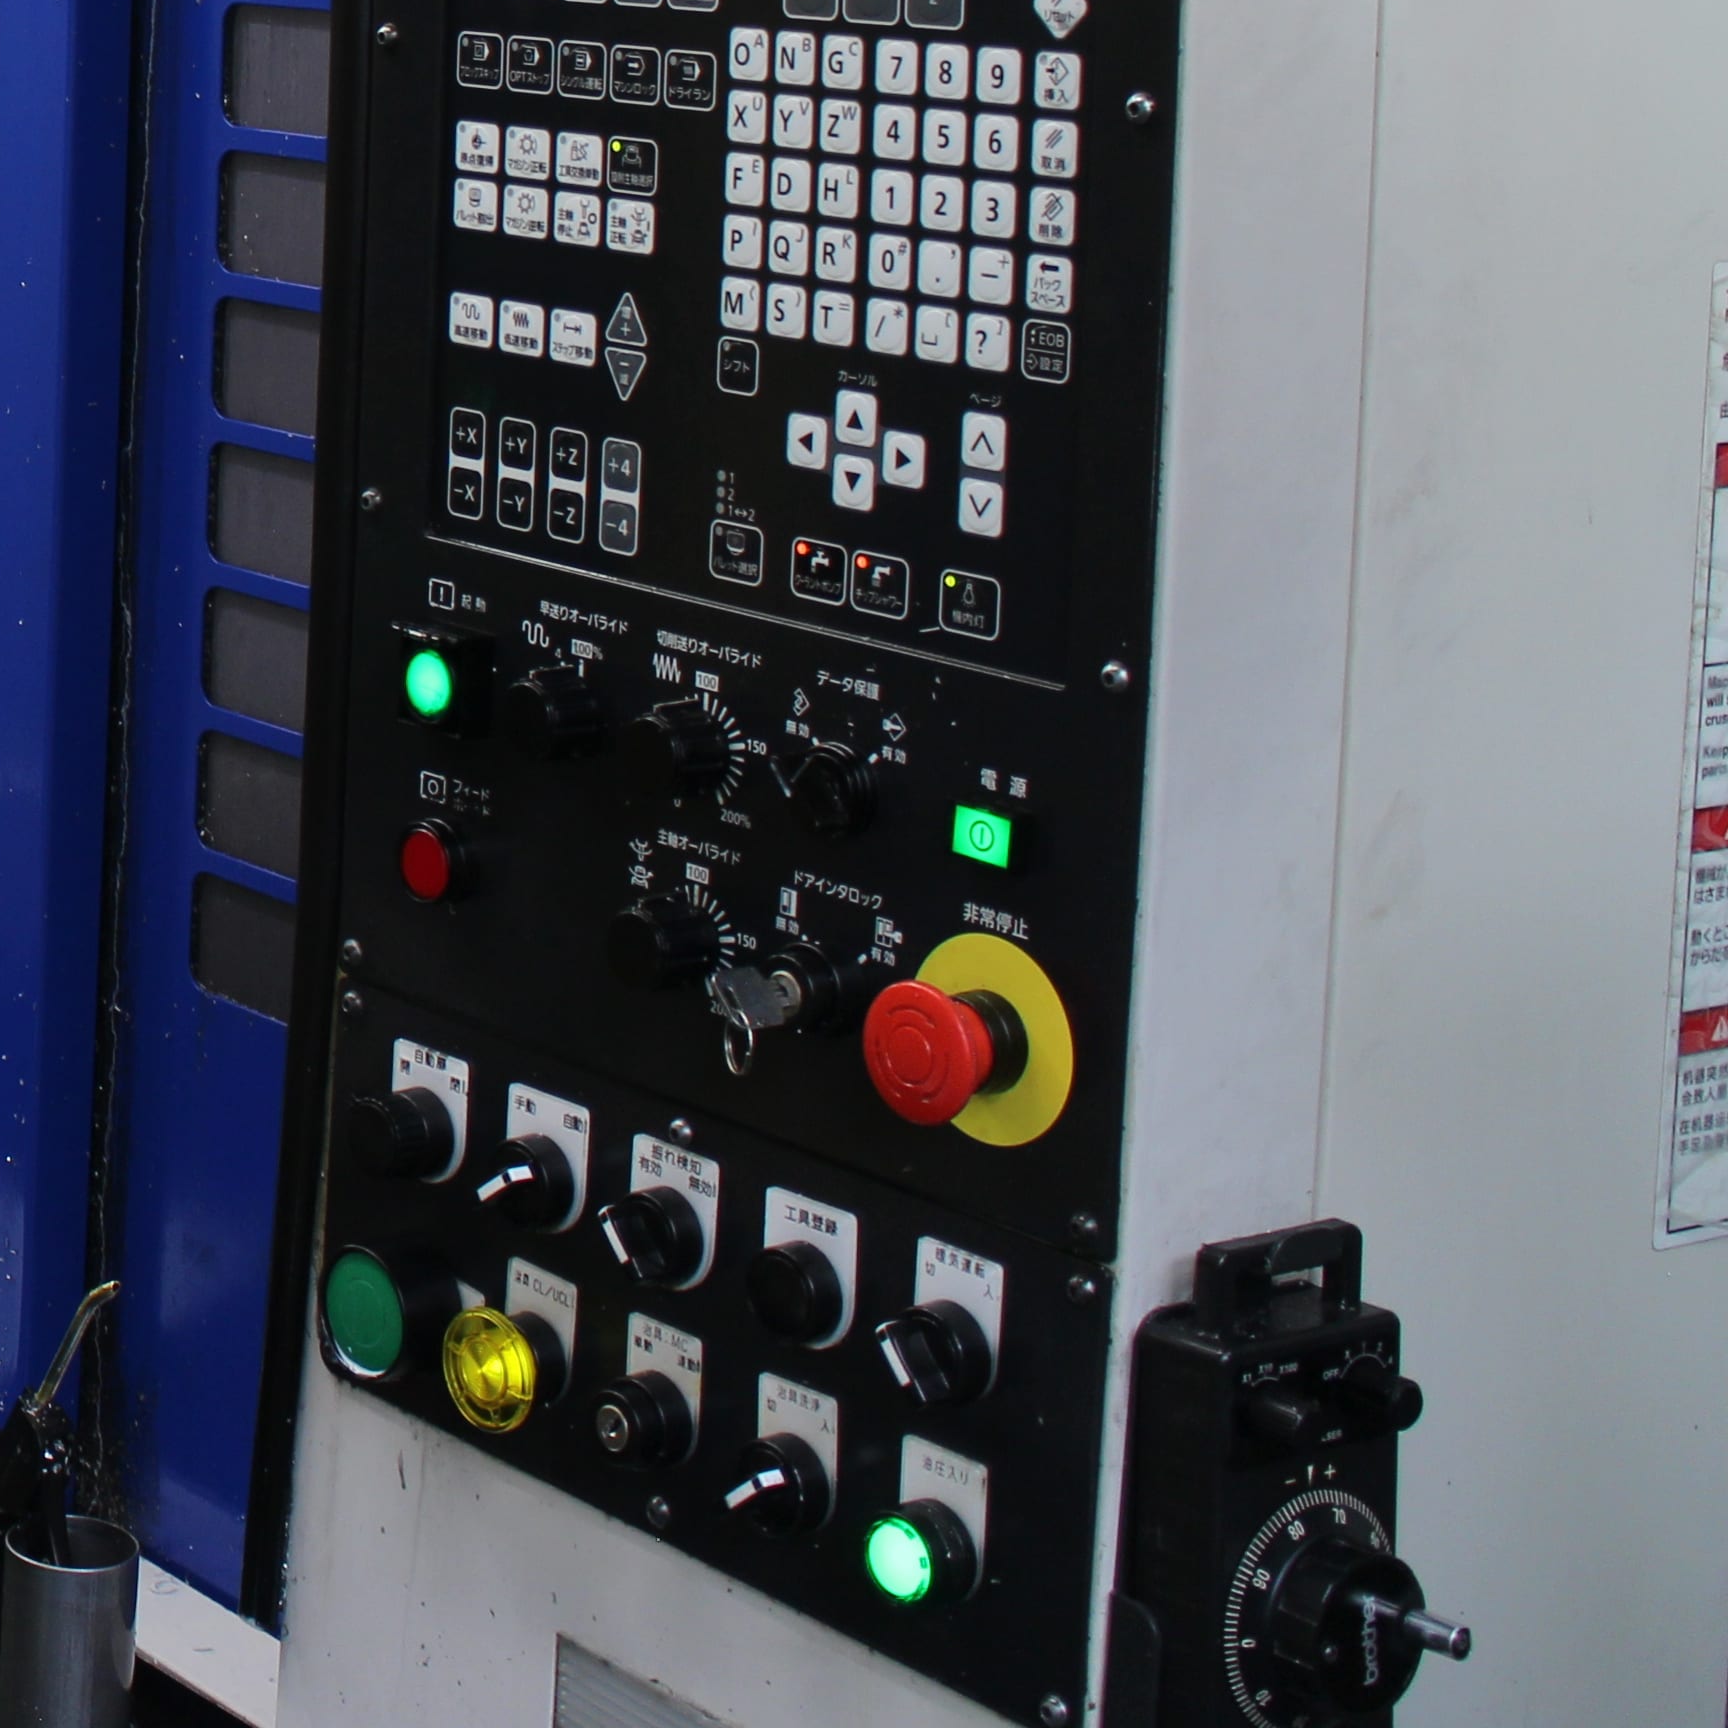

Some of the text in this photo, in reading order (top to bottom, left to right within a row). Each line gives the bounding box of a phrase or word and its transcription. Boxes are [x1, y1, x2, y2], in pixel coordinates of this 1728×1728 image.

[781, 47, 795, 70] N
[829, 51, 843, 73] G
[891, 56, 903, 79] 7
[940, 60, 951, 84] 8
[992, 65, 1003, 88] 9
[668, 87, 711, 101] ドライラン
[733, 105, 747, 128] X
[780, 109, 792, 132] Y
[828, 114, 839, 138] Z
[887, 120, 900, 143] 4
[938, 125, 949, 148] 5
[989, 130, 1001, 153] 6
[733, 167, 743, 190] F
[777, 173, 792, 195] D
[825, 178, 838, 201] H
[935, 192, 947, 216] 2
[987, 198, 998, 222] 3
[731, 230, 742, 252] P
[774, 235, 790, 261] Q
[823, 242, 835, 266] R
[882, 249, 893, 273] 0
[725, 291, 743, 315] M
[775, 299, 785, 323] S
[821, 306, 833, 329] T
[724, 359, 749, 373] シフト
[838, 370, 877, 387] カーソル
[456, 426, 477, 444] +X
[506, 436, 527, 454] +Y
[556, 448, 578, 466] +Z
[609, 457, 630, 476] +4
[696, 674, 717, 690] 100
[747, 739, 766, 755] 150
[688, 866, 708, 882] 100
[794, 870, 882, 910] ドアインタロック
[963, 902, 1028, 940] 非常停止
[737, 933, 756, 949] 150
[1332, 1508, 1346, 1524] 70
[1287, 1520, 1305, 1540] 80
